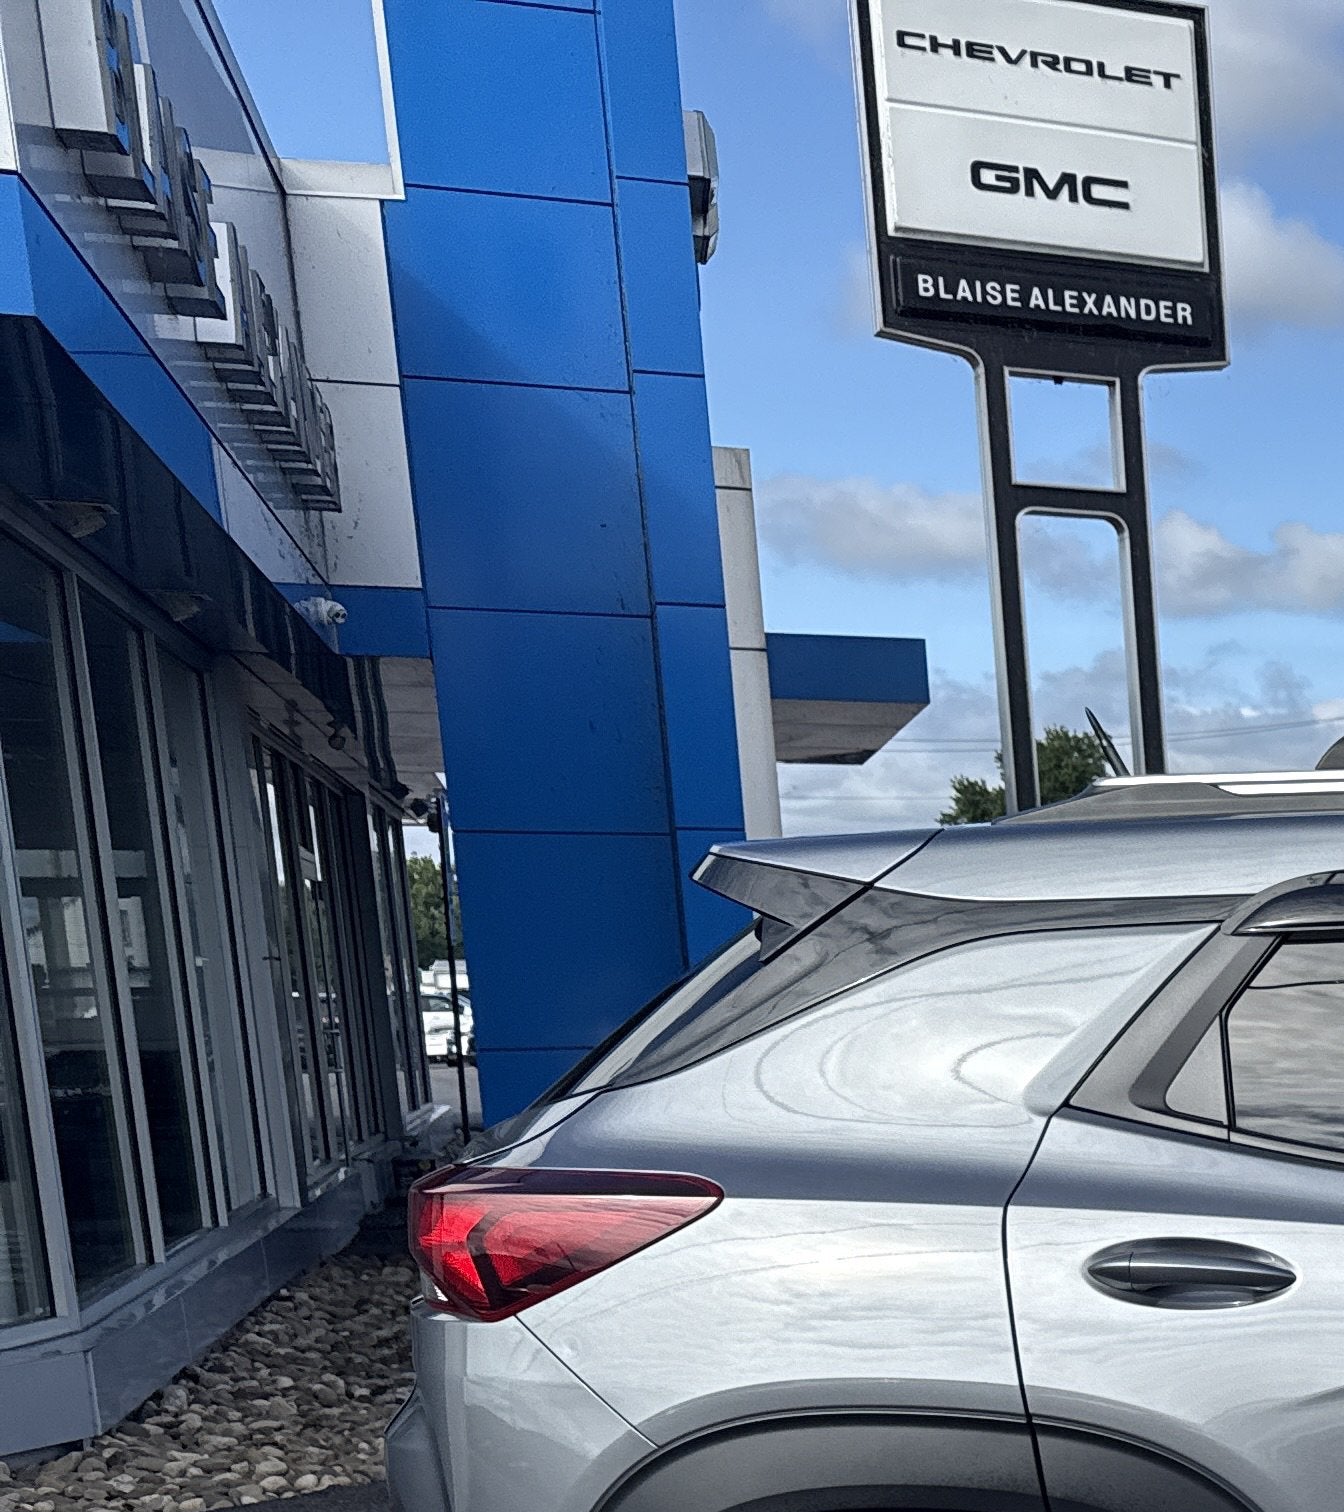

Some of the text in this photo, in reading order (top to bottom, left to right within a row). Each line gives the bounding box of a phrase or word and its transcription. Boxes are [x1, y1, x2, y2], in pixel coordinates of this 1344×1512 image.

[896, 29, 1181, 91] CHEVROLET
[970, 159, 1131, 210] GMC
[917, 272, 1193, 326] BLAISE ALEXANDER
